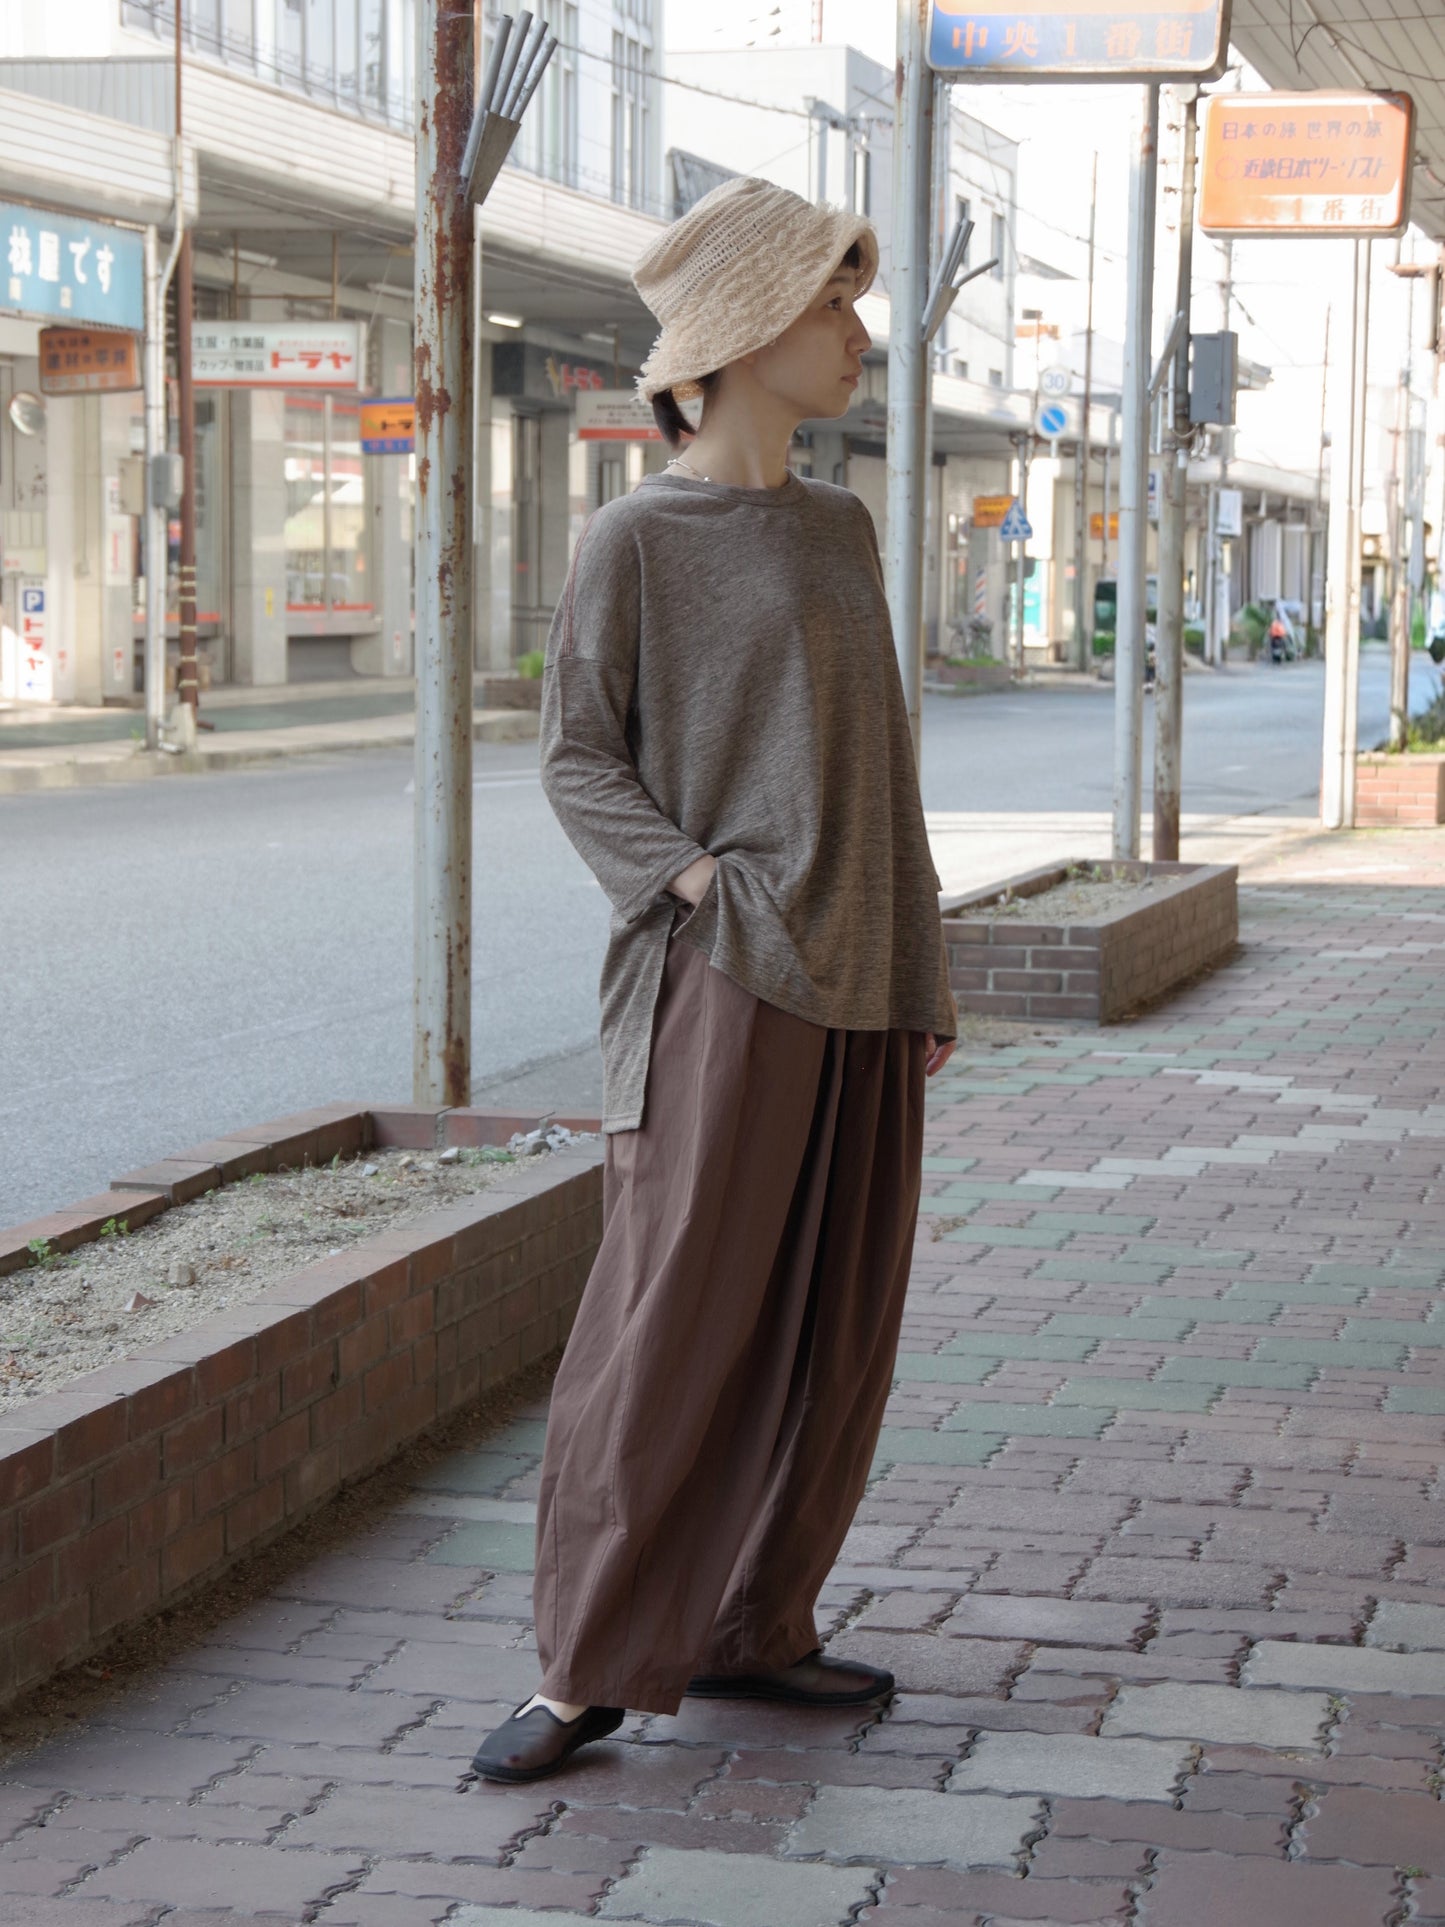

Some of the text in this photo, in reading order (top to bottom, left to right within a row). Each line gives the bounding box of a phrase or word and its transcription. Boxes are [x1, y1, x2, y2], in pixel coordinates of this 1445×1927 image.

[951, 20, 1194, 59] 中央1番街
[1222, 120, 1383, 140] 日本の旅 世界の旅
[1243, 156, 1390, 179] 近畿日本ツーリスト
[1246, 198, 1385, 223] 央1番街
[271, 351, 352, 370] トラヤ
[1044, 373, 1065, 390] 30
[26, 591, 42, 611] P
